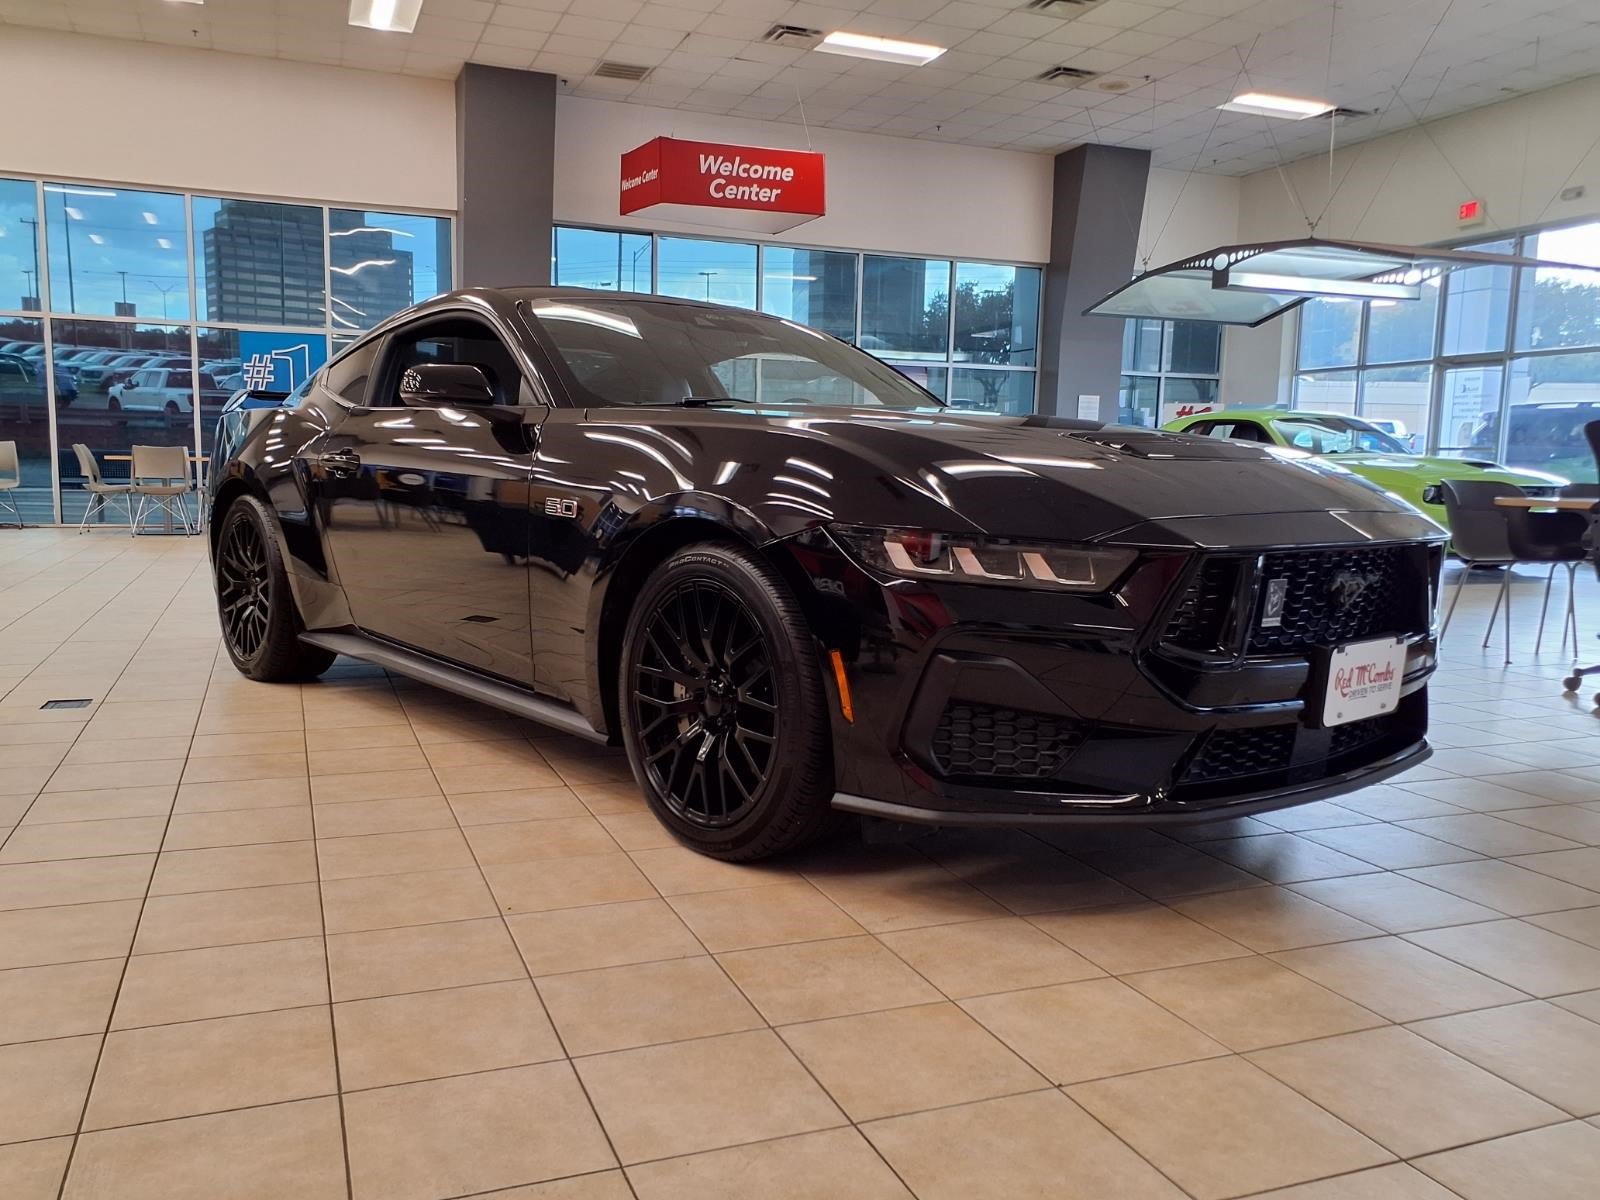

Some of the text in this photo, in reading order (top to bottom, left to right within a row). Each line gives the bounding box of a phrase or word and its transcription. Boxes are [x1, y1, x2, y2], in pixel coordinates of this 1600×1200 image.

[621, 169, 658, 192] Welcome Center
[699, 154, 794, 181] Welcome
[709, 179, 781, 202] Center
[243, 344, 309, 392] #1
[1334, 667, 1354, 698] Red
